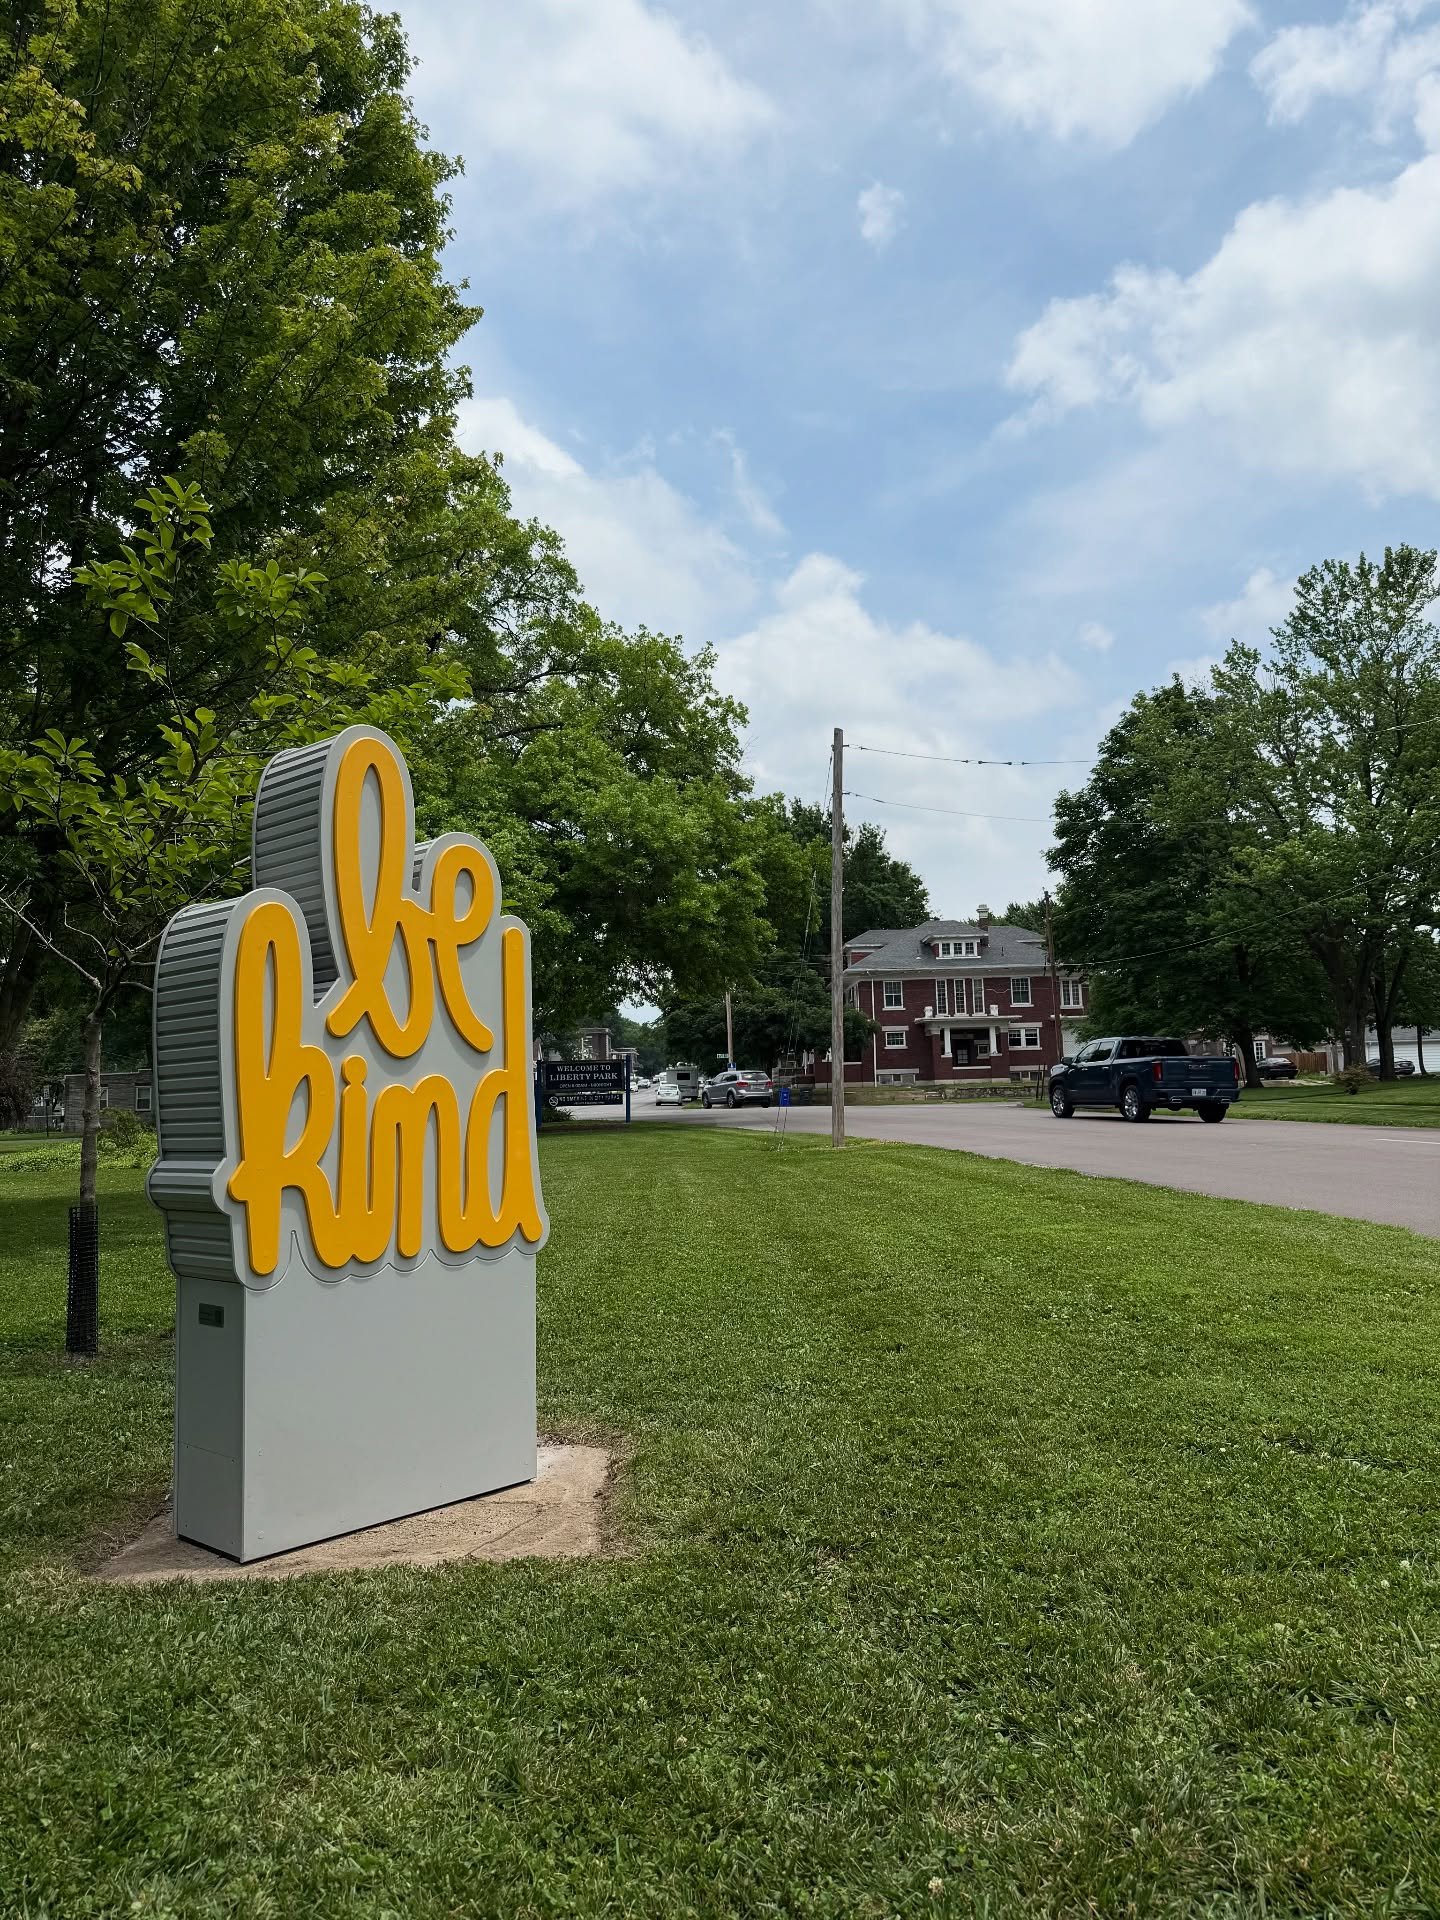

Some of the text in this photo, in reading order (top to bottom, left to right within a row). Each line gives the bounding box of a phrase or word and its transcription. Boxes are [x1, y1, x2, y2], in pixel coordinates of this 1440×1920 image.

[327, 738, 494, 1058] be
[229, 903, 543, 1275] kind
[550, 1072, 618, 1081] LIBERTY PARK
